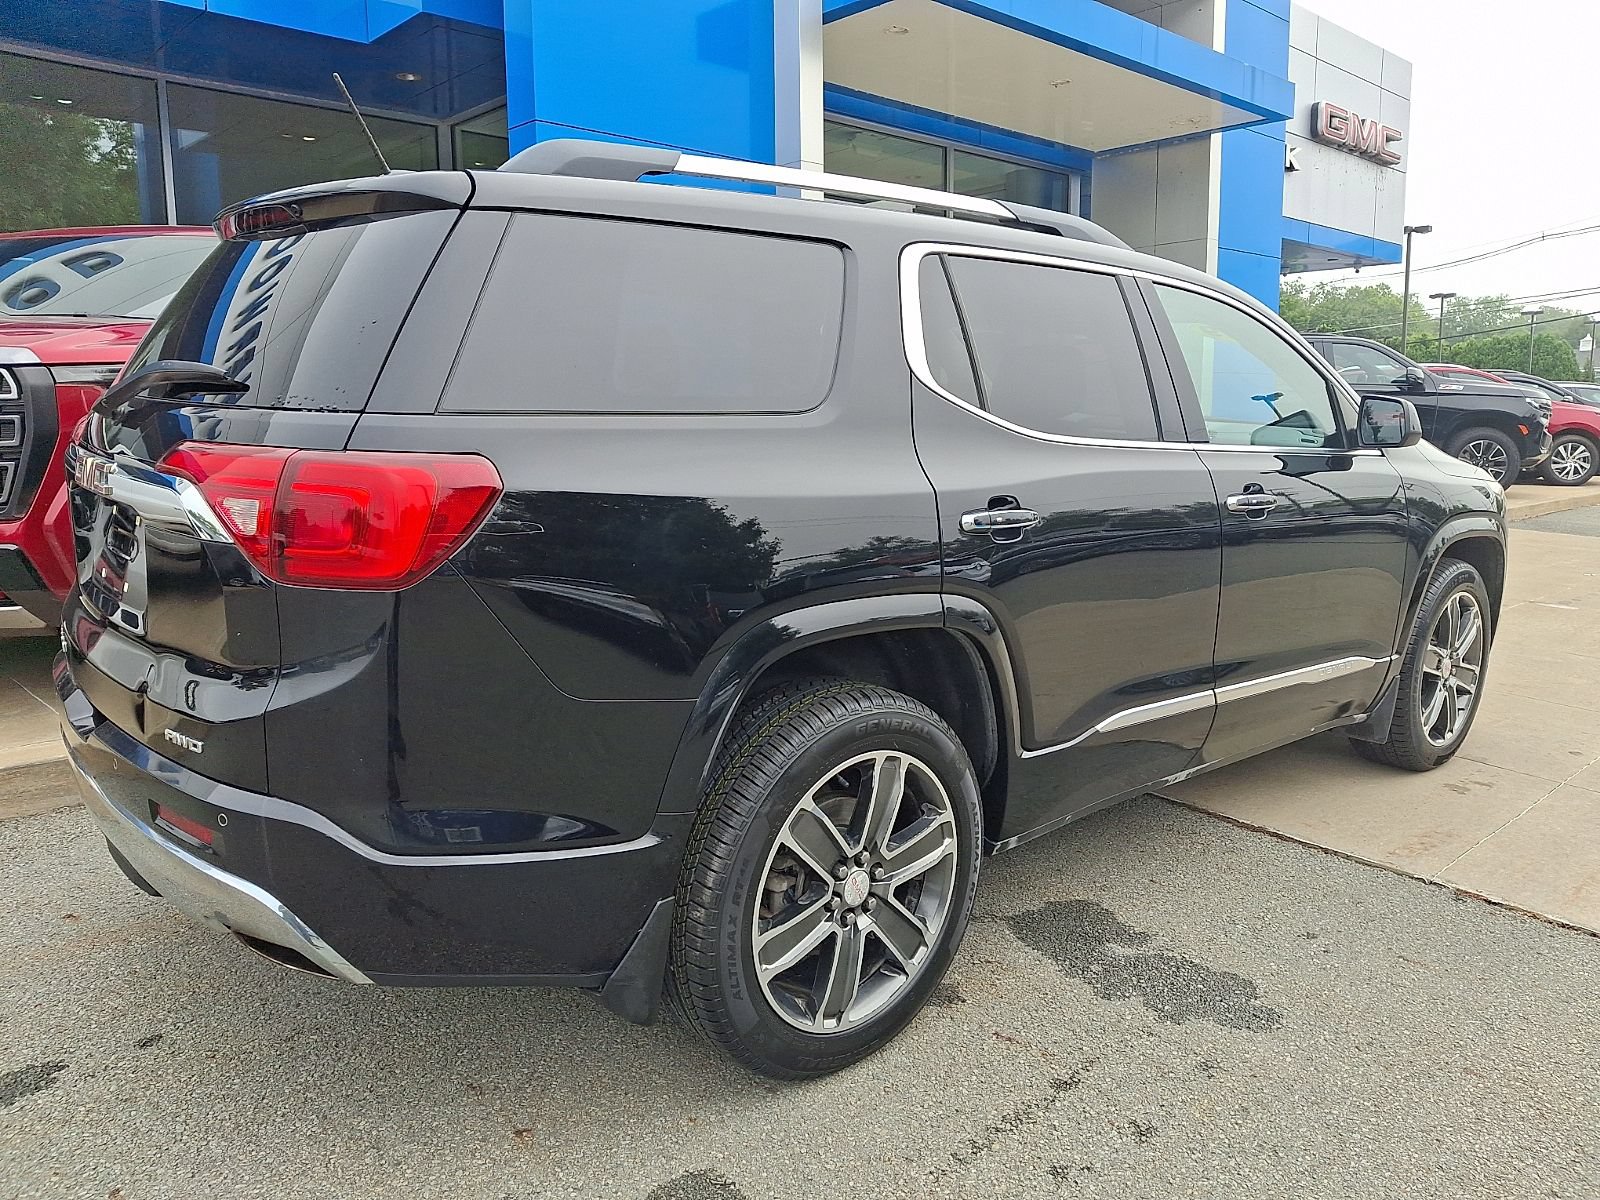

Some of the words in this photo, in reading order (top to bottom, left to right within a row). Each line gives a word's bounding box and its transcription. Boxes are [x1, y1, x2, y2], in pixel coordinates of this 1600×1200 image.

[1314, 101, 1402, 164] GMC
[75, 455, 114, 495] GMC
[164, 728, 205, 754] AWD
[856, 718, 932, 739] GENERAL
[726, 914, 744, 1001] ALTIMAX
